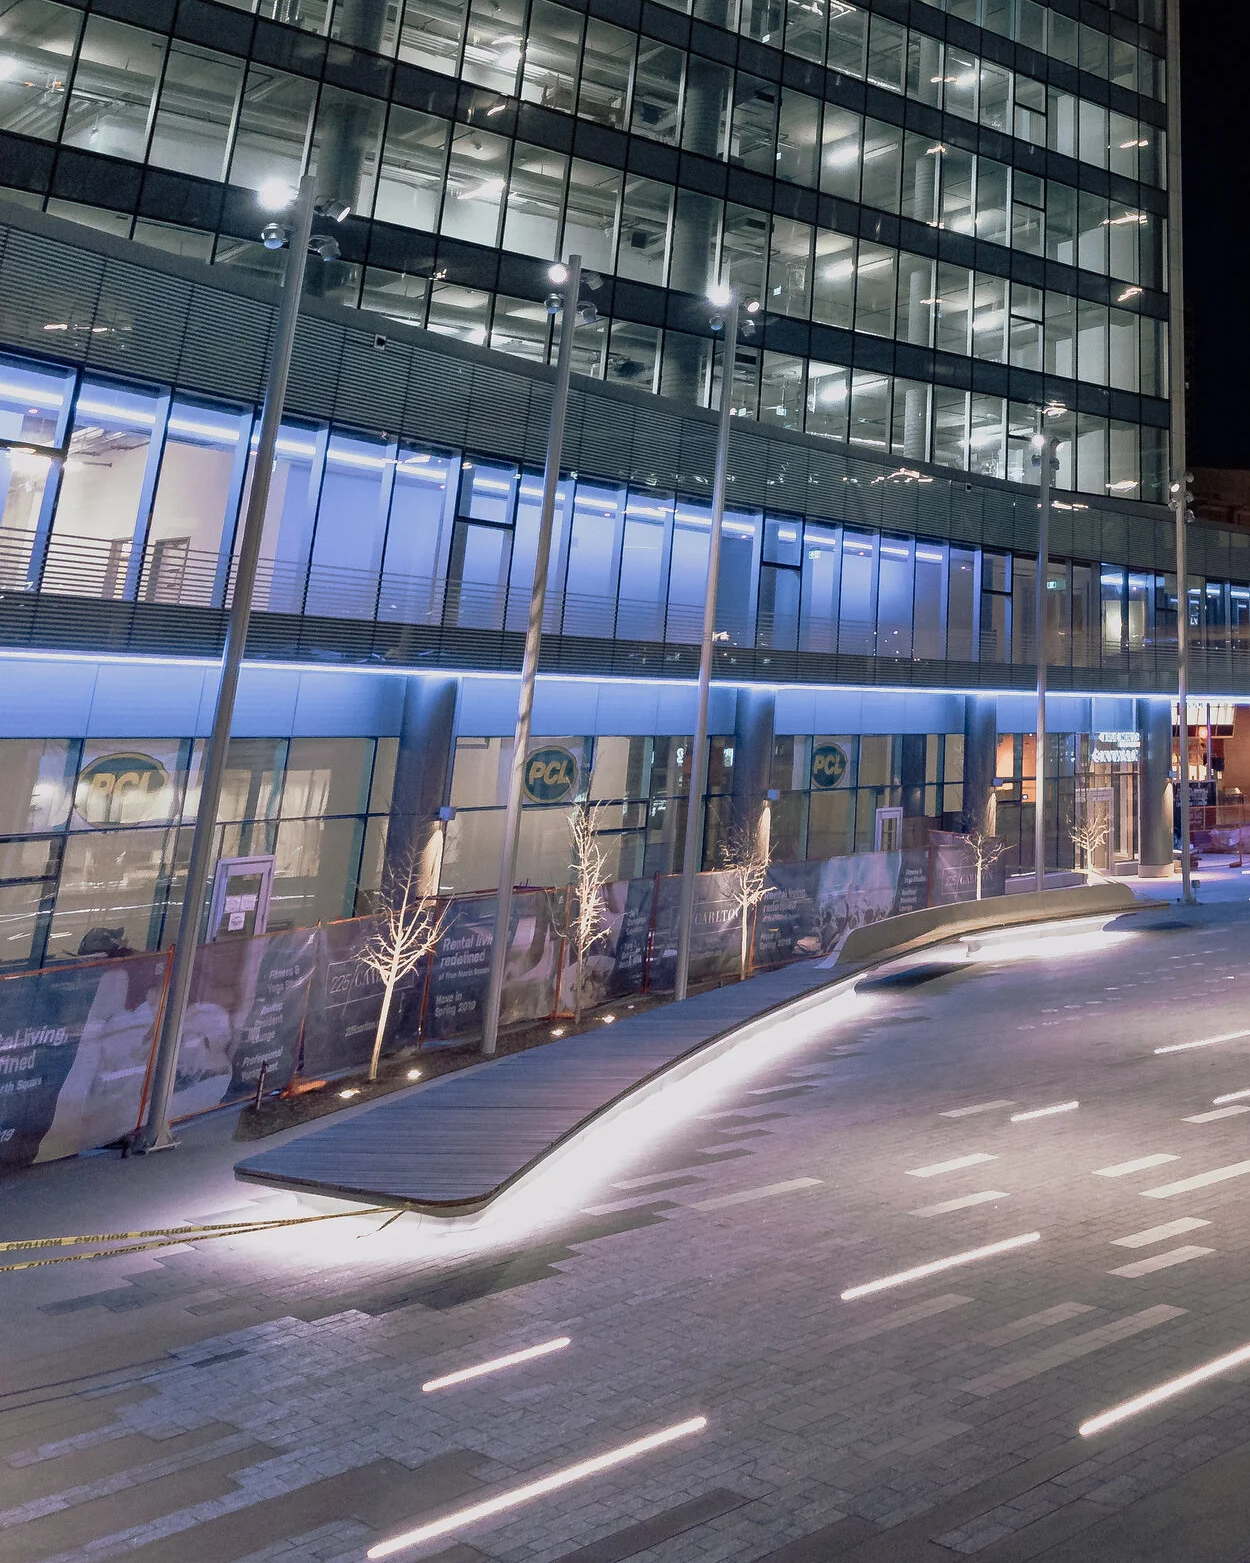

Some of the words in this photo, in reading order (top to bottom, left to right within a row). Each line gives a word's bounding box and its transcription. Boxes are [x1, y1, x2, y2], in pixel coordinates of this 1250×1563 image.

[528, 760, 569, 785] PCL
[813, 755, 843, 775] PCL
[442, 935, 474, 951] Rental
[440, 949, 485, 968] redefined
[436, 994, 453, 1005] Move
[455, 991, 462, 1001] in
[435, 1006, 457, 1017] Spring
[458, 1000, 477, 1014] 2019
[0, 1128, 15, 1142] 19
